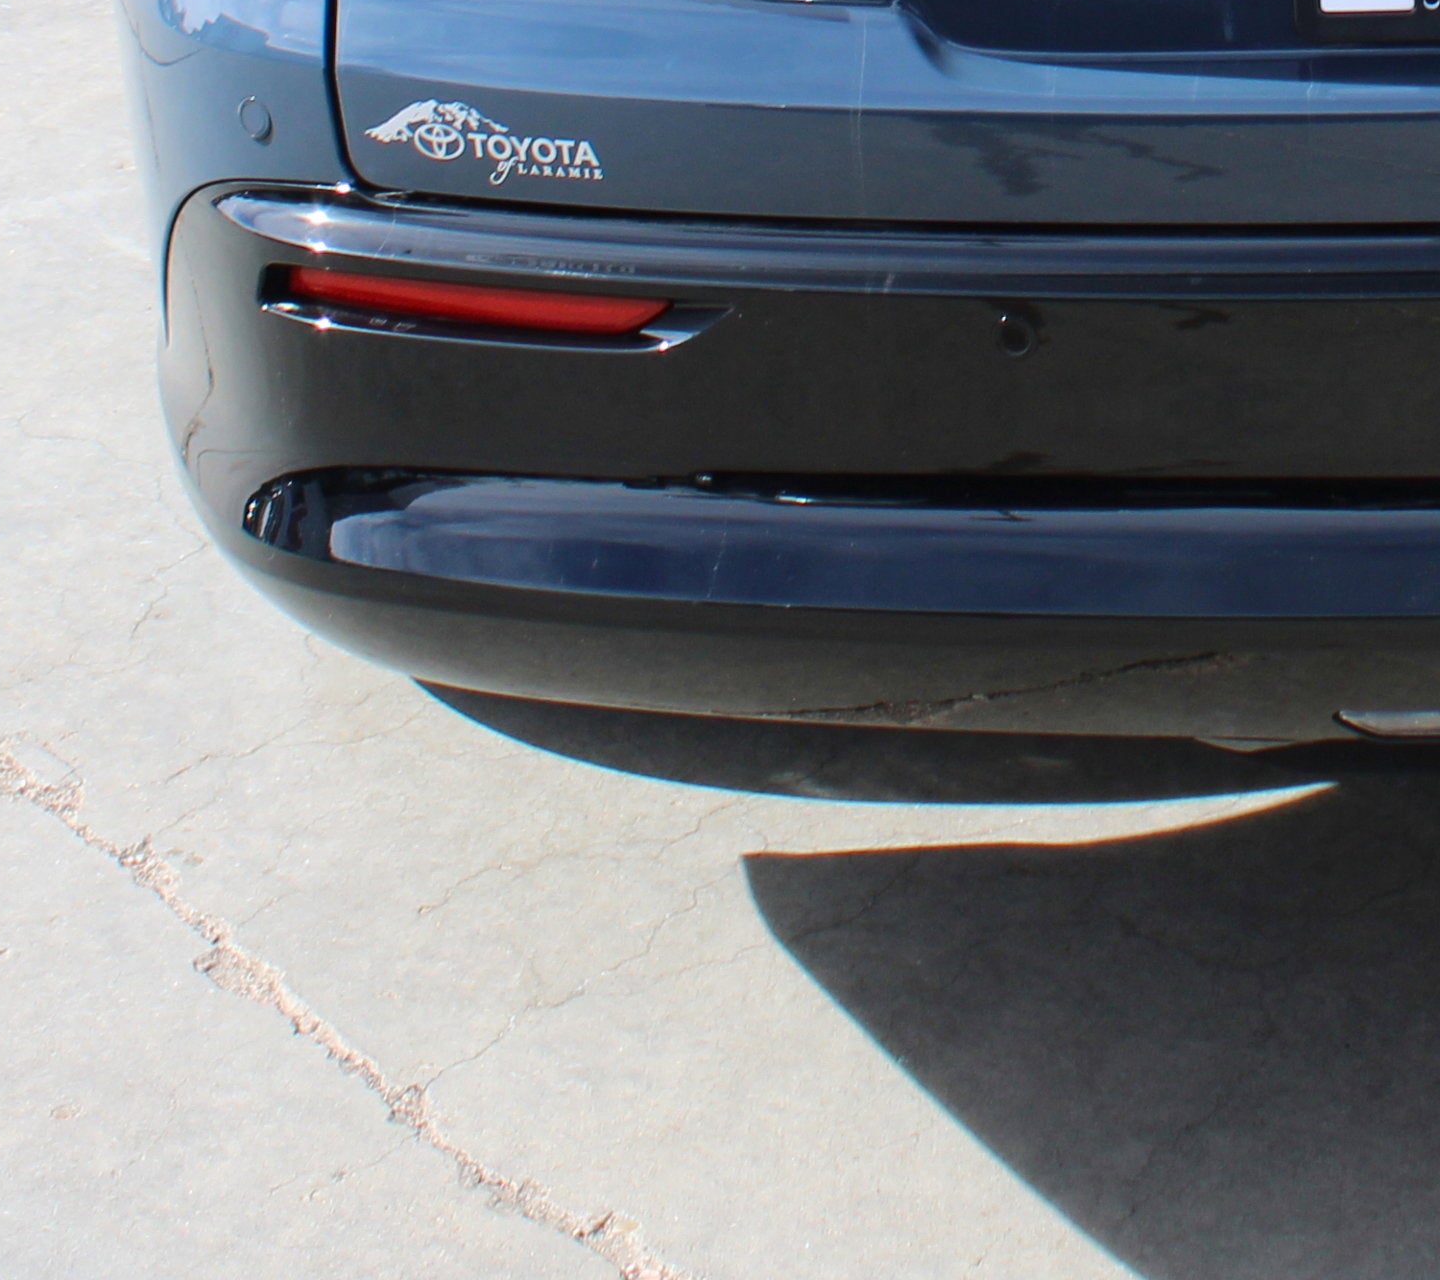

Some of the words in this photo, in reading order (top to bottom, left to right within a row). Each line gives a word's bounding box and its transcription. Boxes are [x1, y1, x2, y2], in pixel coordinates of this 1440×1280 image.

[466, 131, 601, 167] TOYOTA
[489, 155, 520, 186] of
[517, 162, 605, 181] LARAMIE
